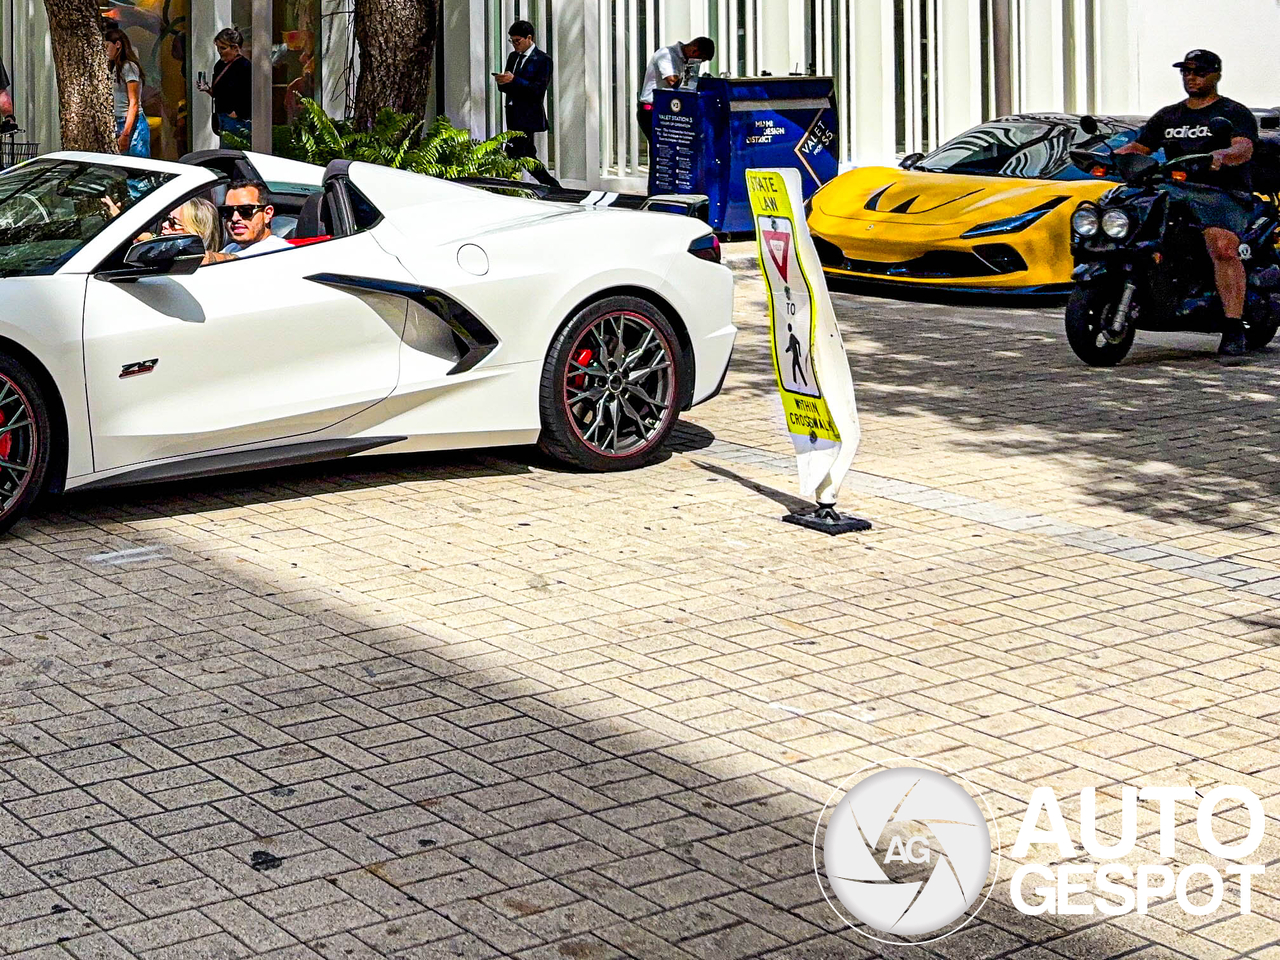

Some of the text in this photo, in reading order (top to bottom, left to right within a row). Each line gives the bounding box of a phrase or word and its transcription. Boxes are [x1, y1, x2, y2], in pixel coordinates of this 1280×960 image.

[801, 120, 825, 154] VALET
[748, 175, 778, 193] STATE
[757, 196, 779, 212] LAW
[786, 302, 796, 316] TO
[794, 397, 820, 416] WITHIN
